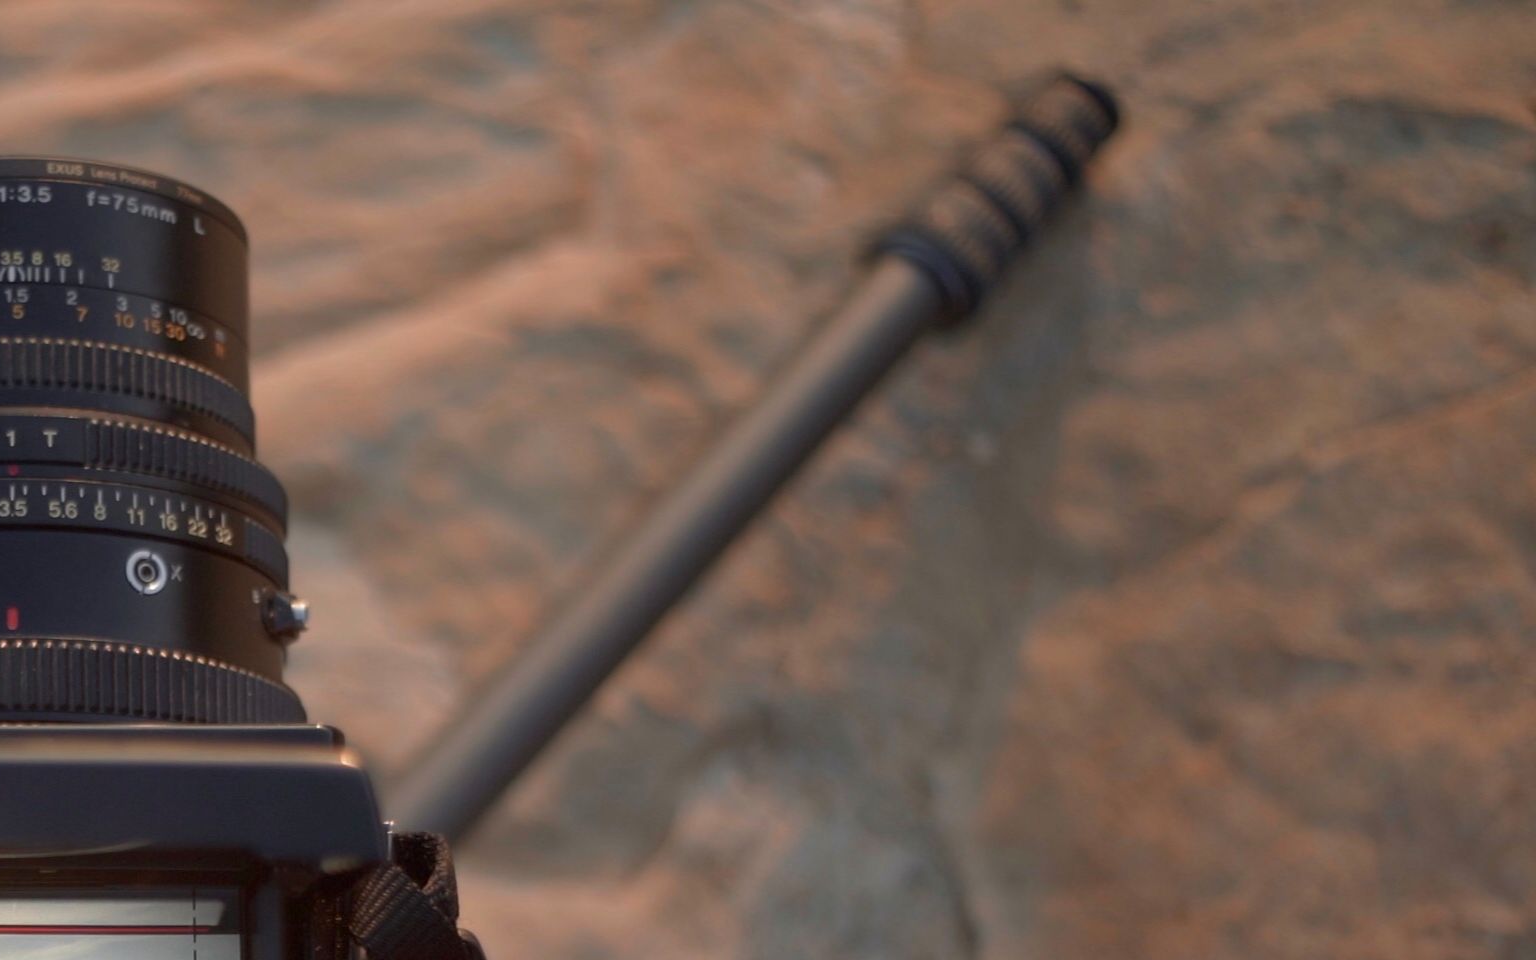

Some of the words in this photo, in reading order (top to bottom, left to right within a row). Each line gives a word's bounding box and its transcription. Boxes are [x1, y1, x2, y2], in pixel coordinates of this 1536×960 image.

[86, 190, 177, 225] f=75mm
[193, 216, 207, 236] L
[31, 251, 44, 266] 8
[54, 252, 73, 268] 16
[101, 257, 121, 273] 32
[4, 288, 30, 304] 1.5
[66, 290, 79, 306] 2
[116, 296, 128, 312] 3
[150, 302, 162, 318] 5
[169, 307, 187, 326] 10
[12, 304, 25, 319] 5
[76, 306, 89, 323] 7
[115, 312, 135, 330] 10
[143, 316, 163, 336] 15
[6, 430, 16, 447] 1
[42, 430, 58, 448] T
[48, 501, 79, 520] 5.6
[93, 504, 107, 521] 8
[127, 508, 145, 526] 11
[159, 512, 179, 532] 16
[187, 517, 208, 538] 22
[215, 523, 234, 546] 32
